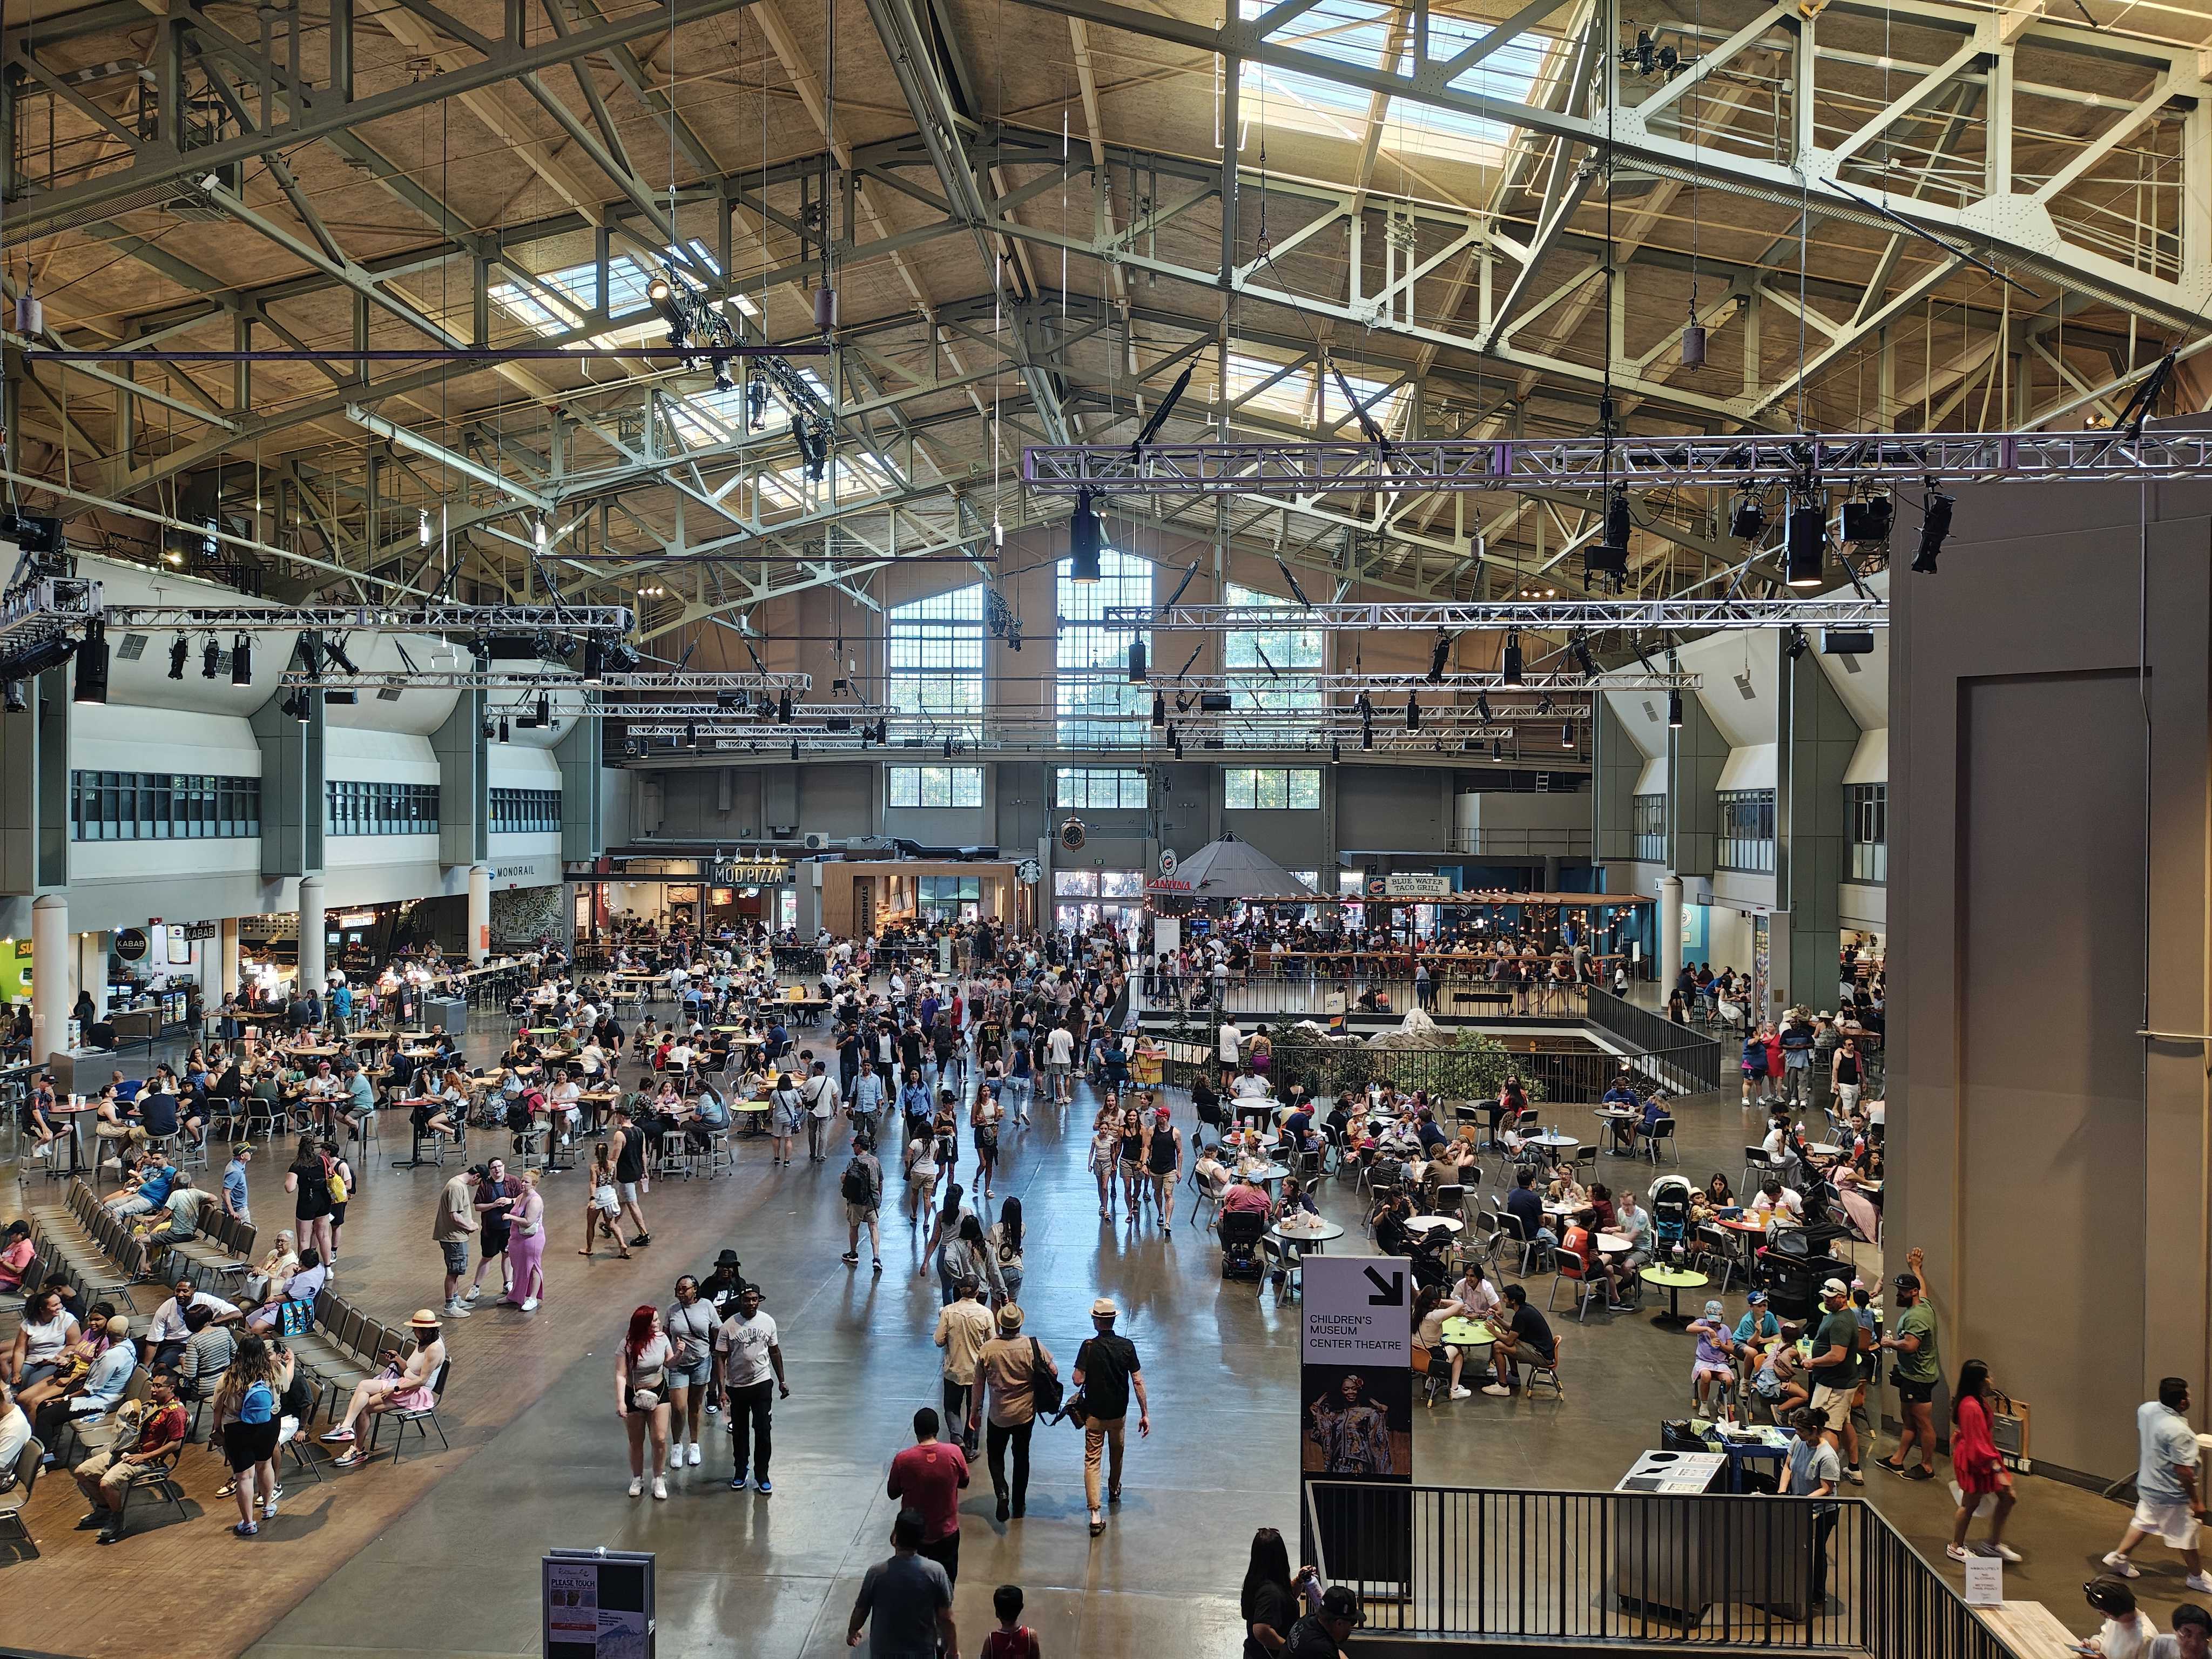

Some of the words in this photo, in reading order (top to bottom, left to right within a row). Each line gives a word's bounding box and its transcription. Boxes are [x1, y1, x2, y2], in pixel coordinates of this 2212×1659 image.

[497, 865, 535, 877] MONORAIL
[715, 867, 744, 882] MOD
[747, 868, 783, 883] PIZZA
[1147, 879, 1190, 890] CANTINA
[185, 928, 214, 940] KABAB
[1563, 1234, 1576, 1248] 10
[1310, 1314, 1372, 1325] CHILDREN'S
[1310, 1325, 1357, 1335] MUSEUM
[734, 1328, 767, 1344] HOODRICH
[1310, 1339, 1352, 1348] CENTER
[1354, 1340, 1401, 1350] THEATRE
[551, 1579, 574, 1587] PLEASE
